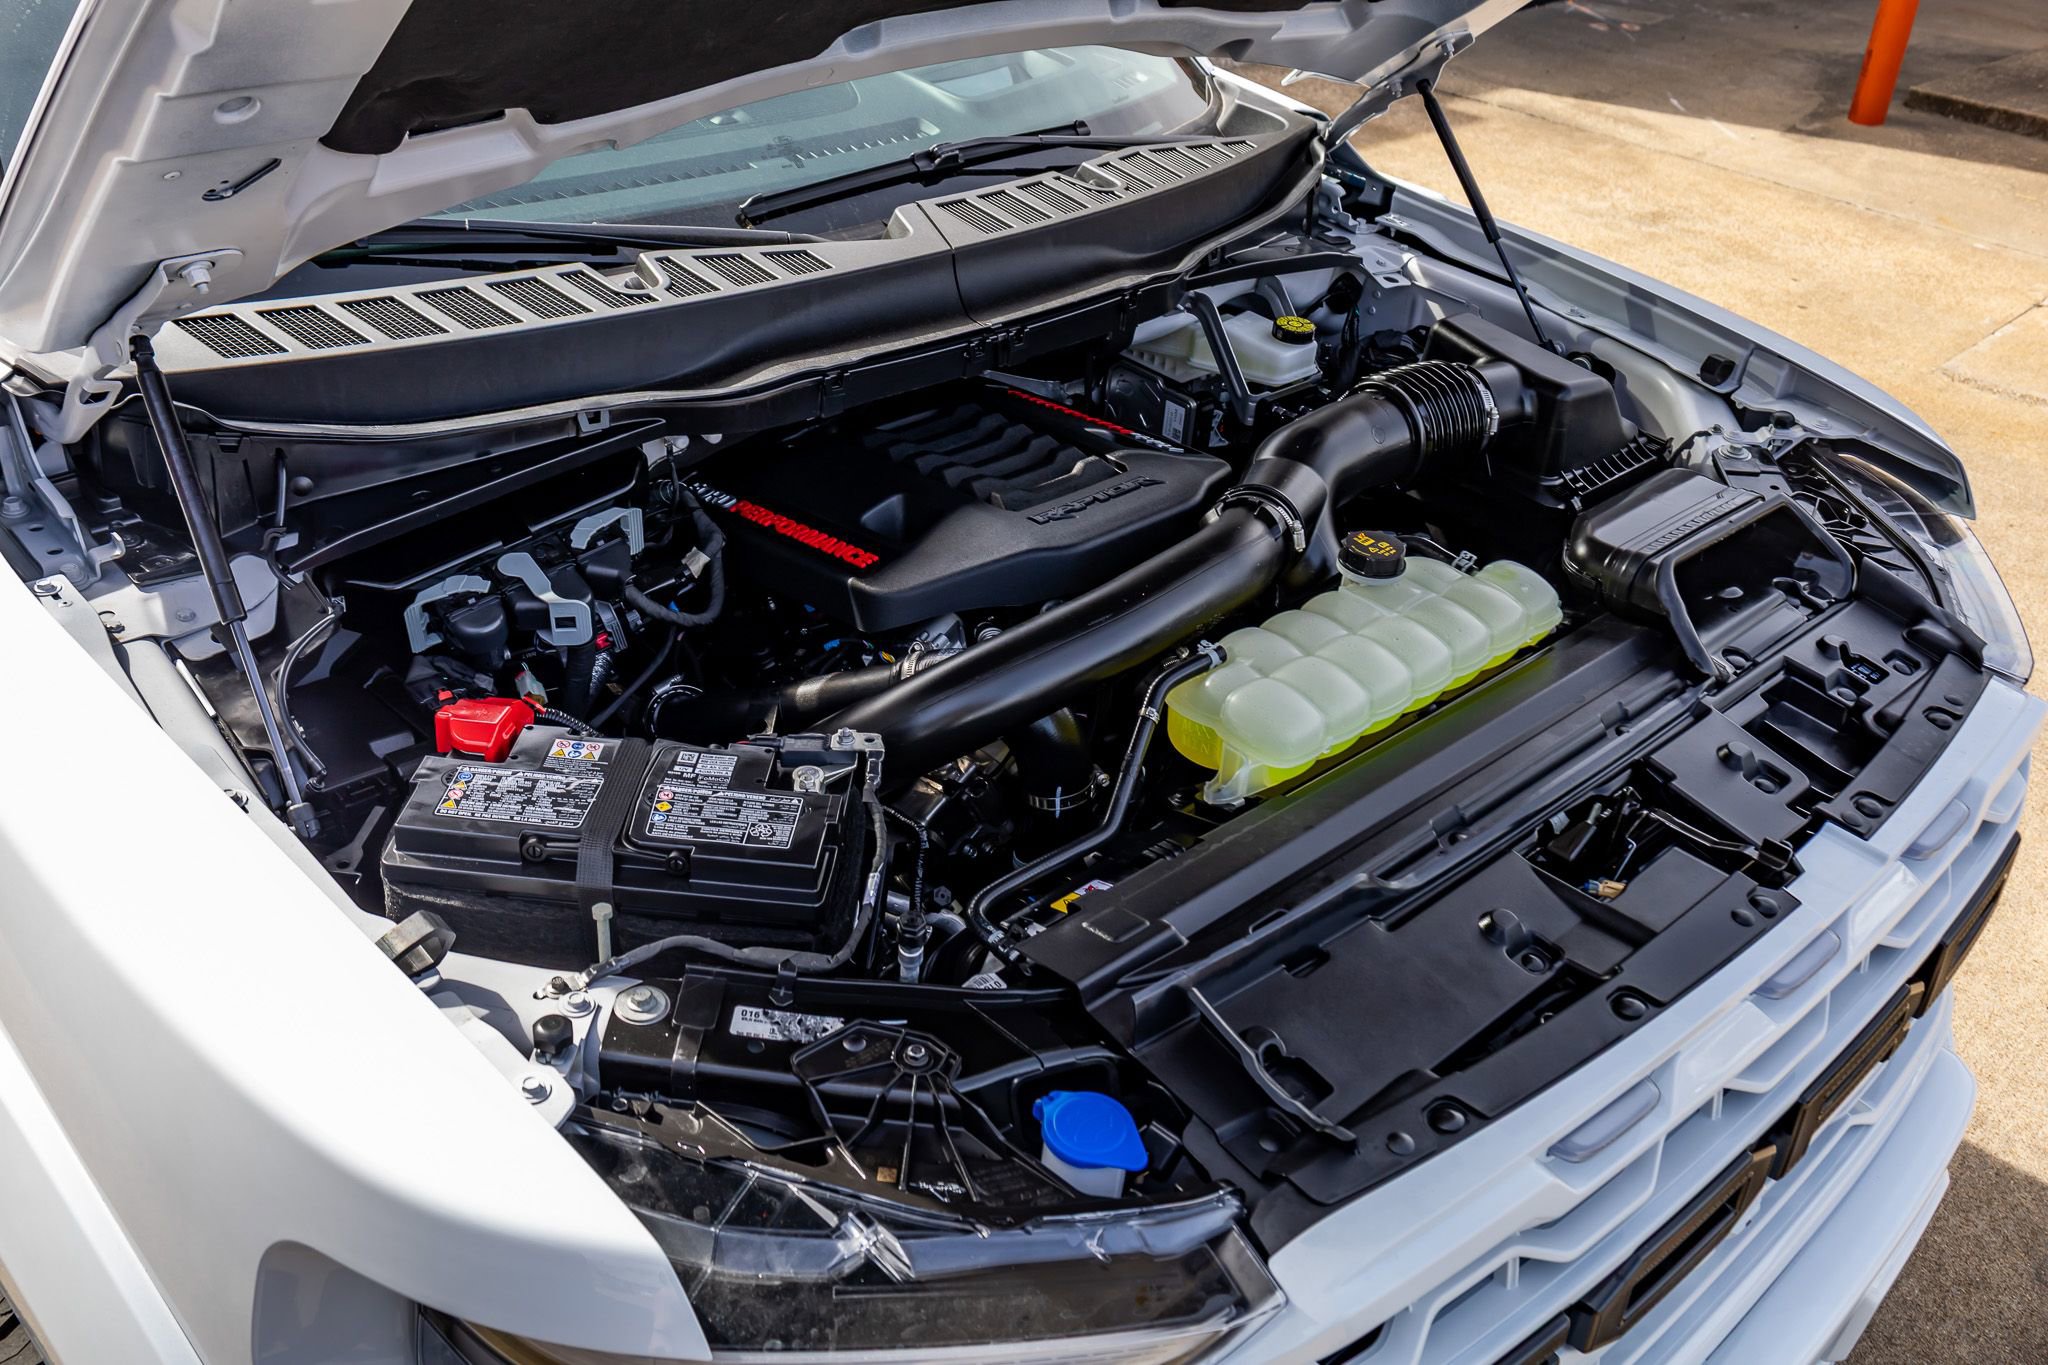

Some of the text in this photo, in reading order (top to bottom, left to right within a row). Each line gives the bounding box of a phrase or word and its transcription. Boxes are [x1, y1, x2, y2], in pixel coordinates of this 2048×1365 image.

[1026, 475, 1168, 525] RAPTOR
[729, 500, 879, 569] PERFORMANCE
[741, 1009, 760, 1018] 016
